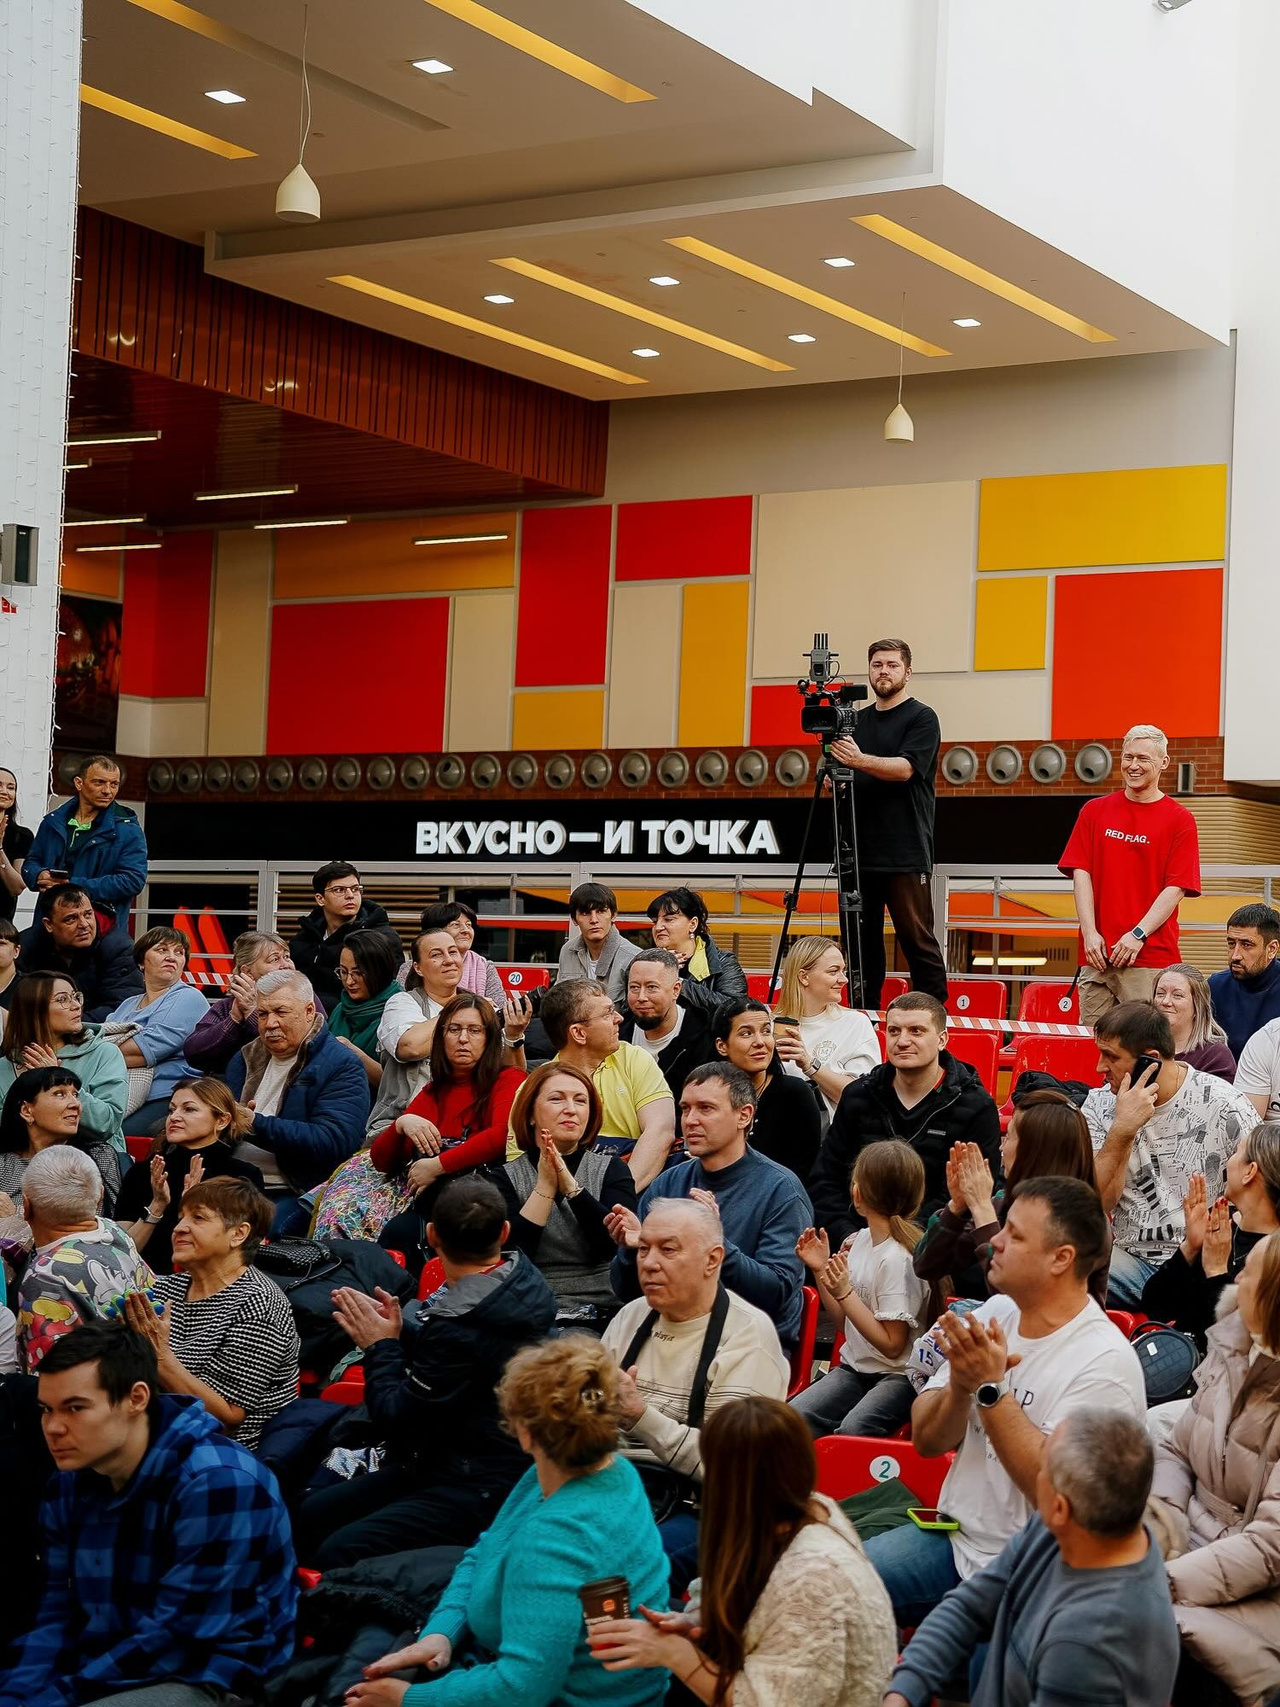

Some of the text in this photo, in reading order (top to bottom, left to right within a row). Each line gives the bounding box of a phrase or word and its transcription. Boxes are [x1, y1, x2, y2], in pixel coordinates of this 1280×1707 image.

[641, 820, 782, 855] ТОЧКА
[1105, 828, 1125, 840] RED
[919, 1348, 934, 1367] 15
[879, 1460, 890, 1479] 2
